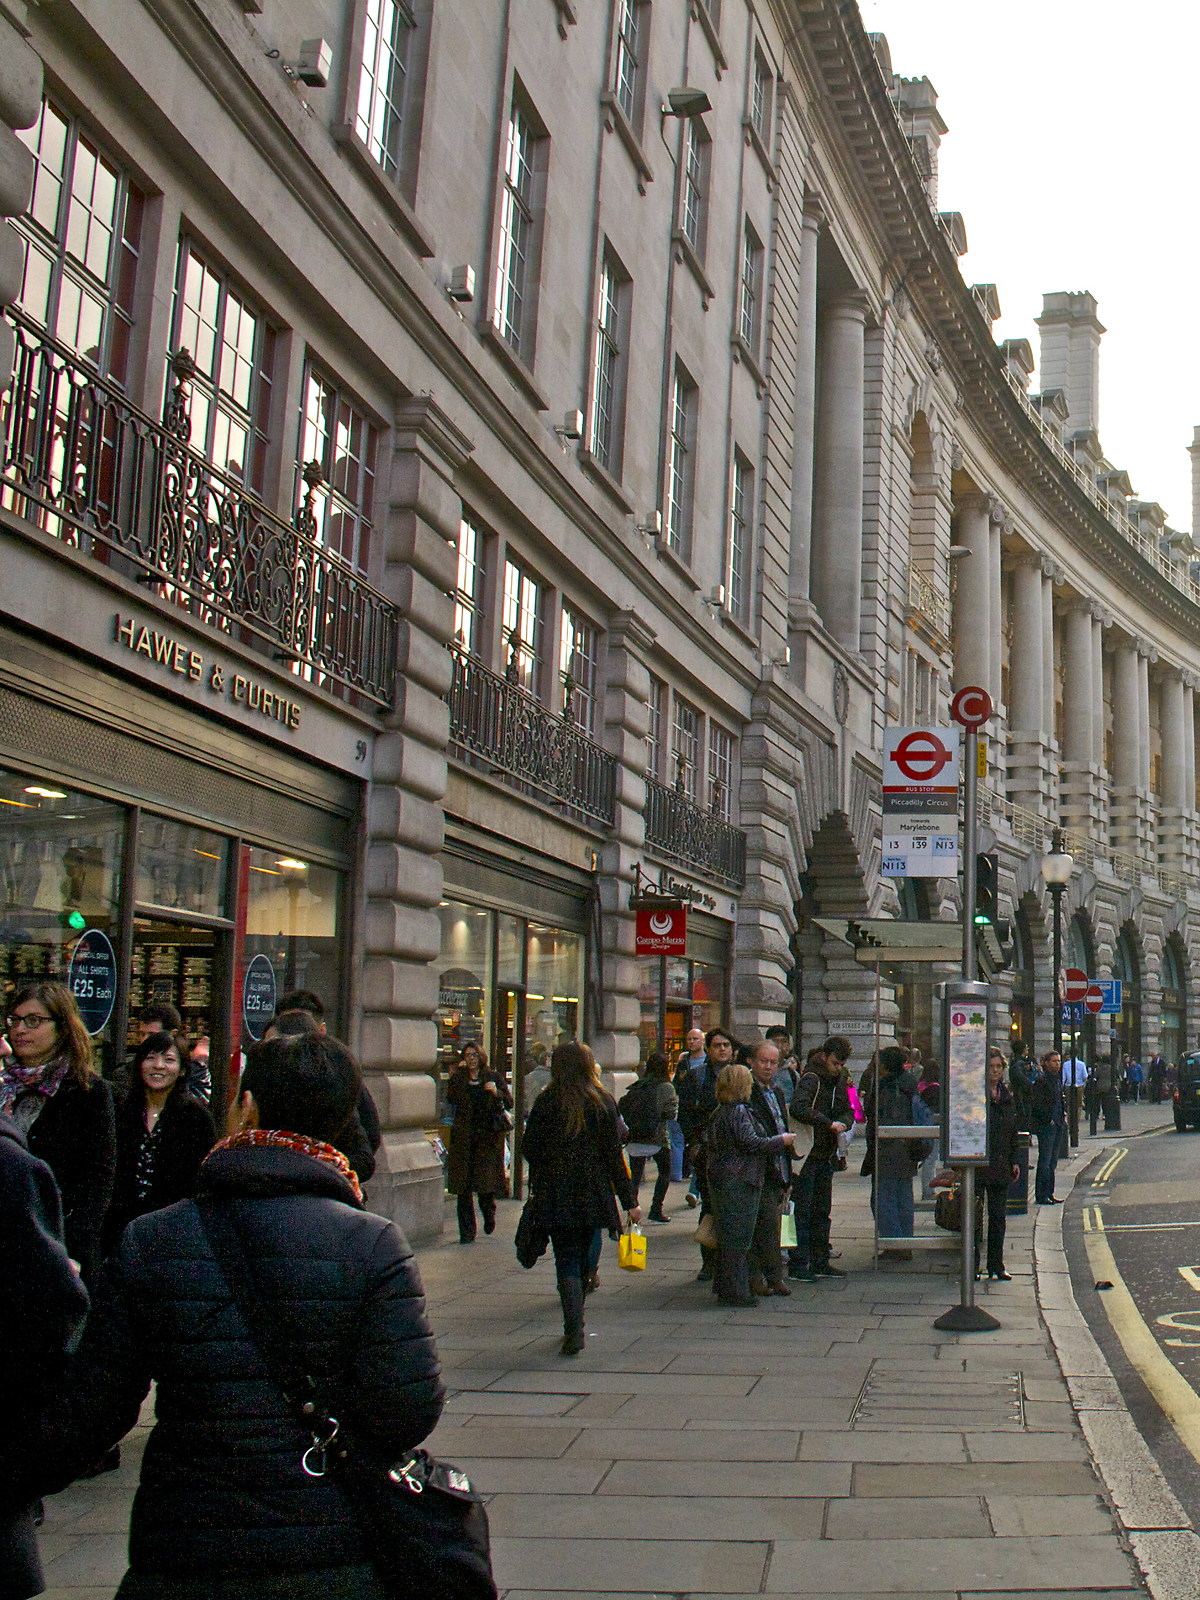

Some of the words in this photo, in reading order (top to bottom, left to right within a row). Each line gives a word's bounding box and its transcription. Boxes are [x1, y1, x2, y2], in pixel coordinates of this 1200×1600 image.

[115, 613, 203, 681] HAWES
[210, 663, 225, 692] &
[233, 674, 301, 730] CURTIS
[958, 692, 983, 721] C
[891, 799, 924, 807] Piccadilly
[900, 824, 940, 832] Marylebone
[889, 841, 900, 849] 13
[912, 841, 928, 849] 139
[935, 841, 954, 849] N13
[882, 861, 906, 870] N113
[636, 936, 661, 945] Campo
[662, 936, 685, 945] Marzio
[79, 964, 89, 975] ALL
[90, 966, 109, 976] SHIRTS
[73, 979, 94, 998] £25
[96, 987, 112, 999] Each
[247, 994, 260, 1010] £25
